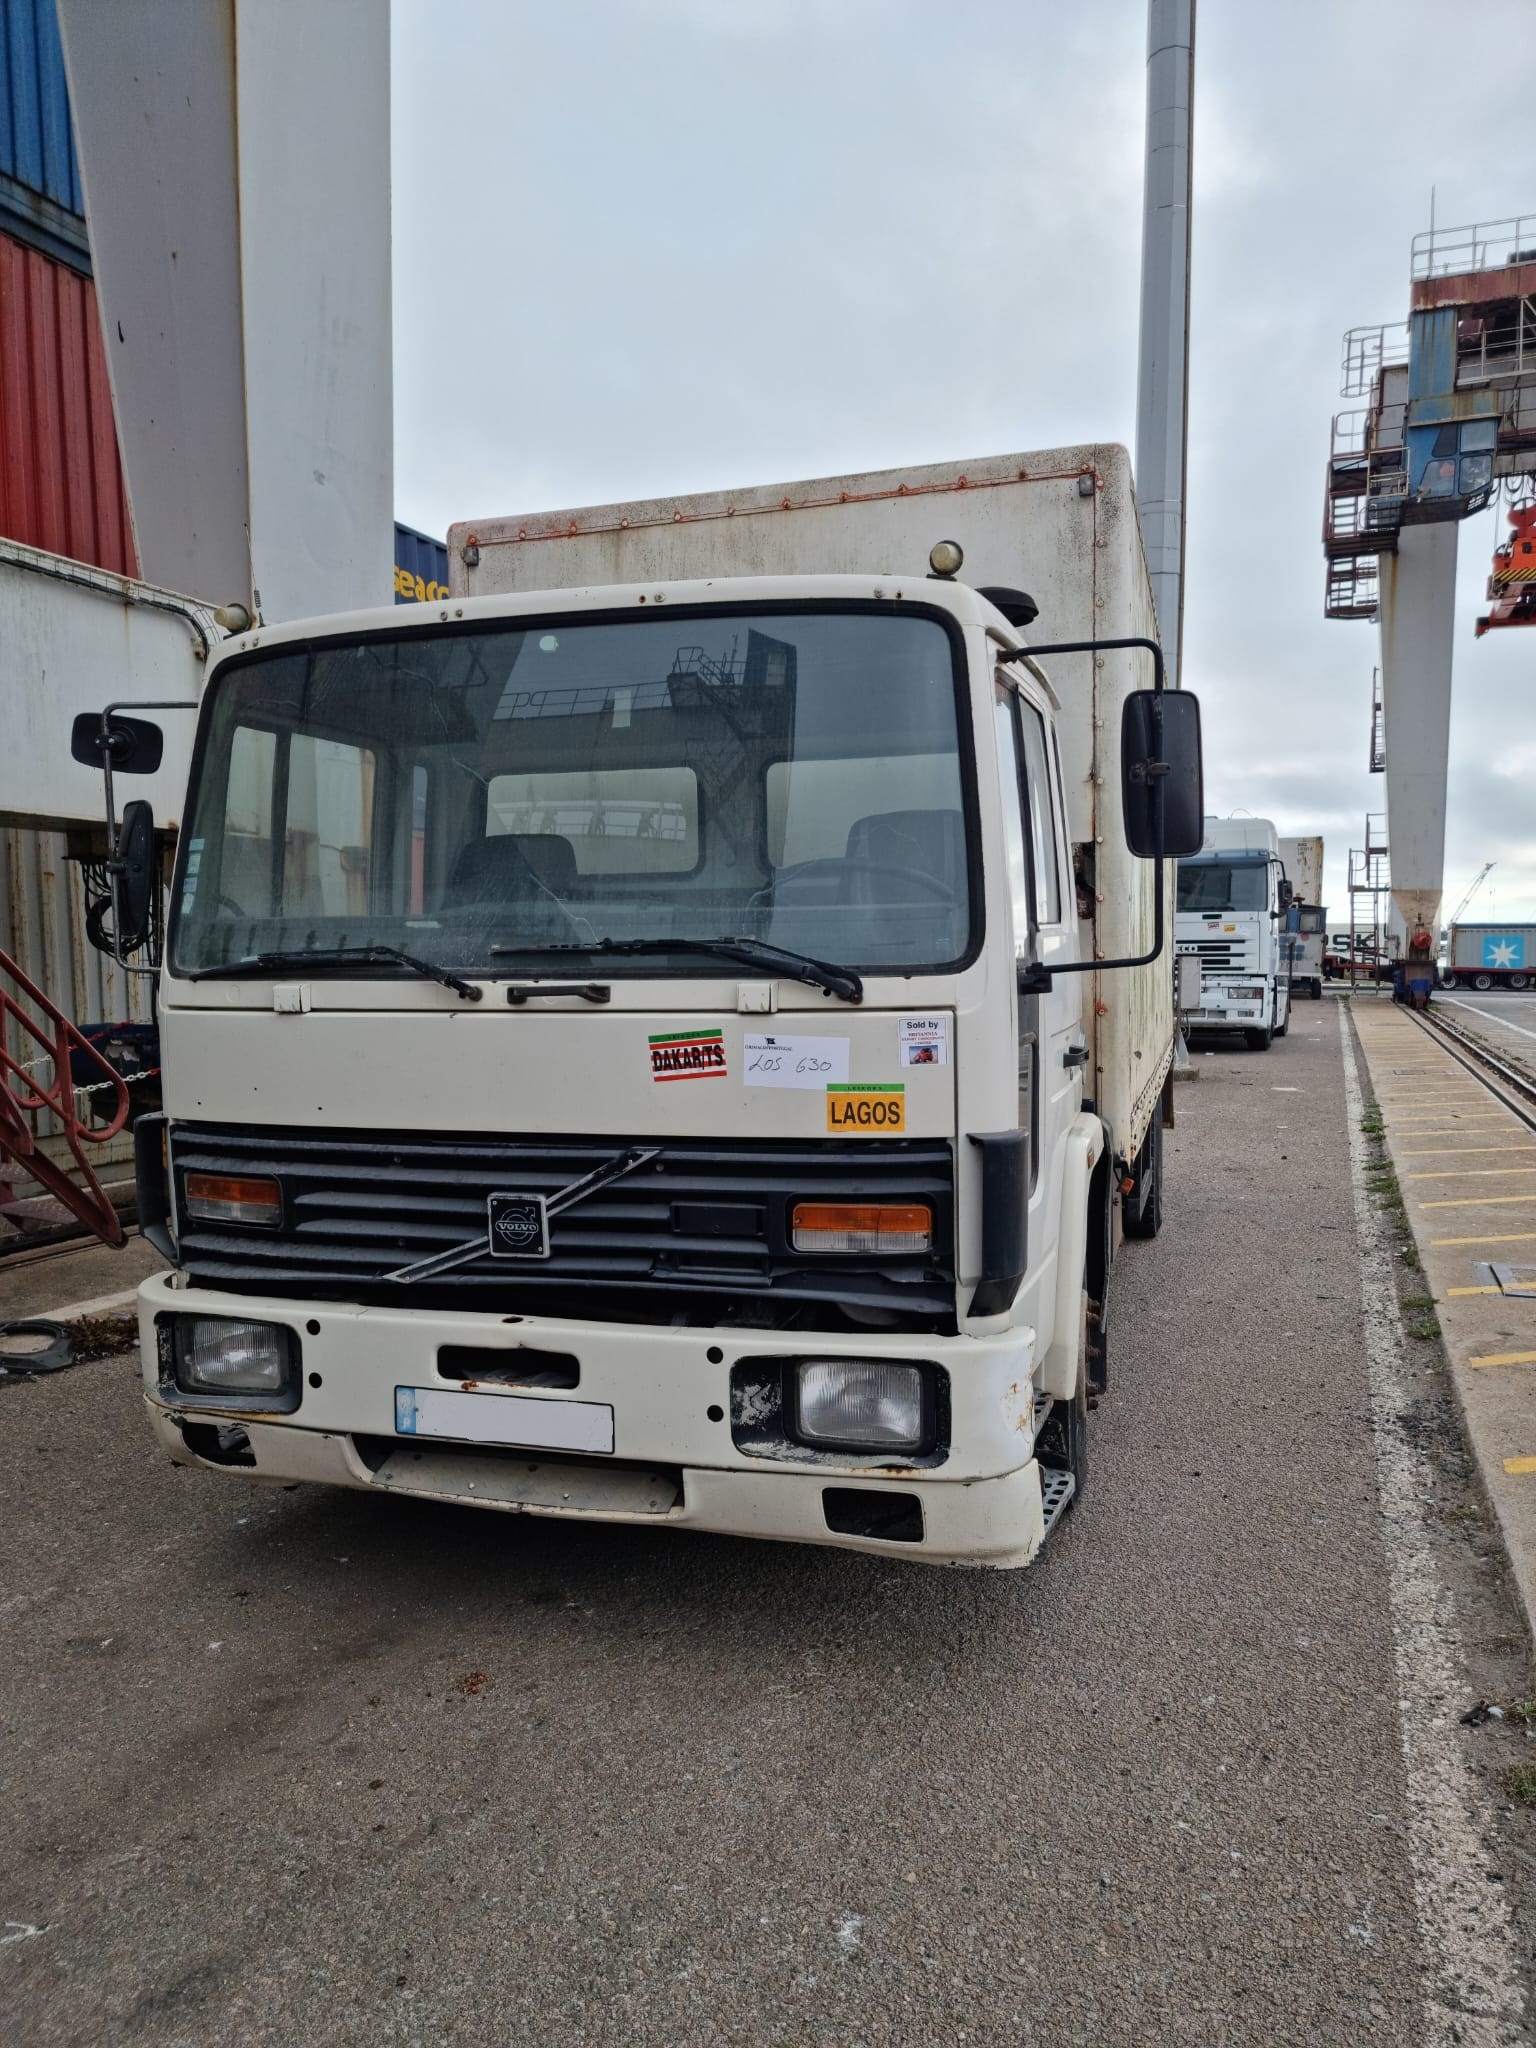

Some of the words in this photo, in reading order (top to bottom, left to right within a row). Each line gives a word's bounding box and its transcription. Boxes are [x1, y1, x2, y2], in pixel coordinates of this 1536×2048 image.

[906, 1021, 926, 1029] Sold
[928, 1020, 939, 1030] by
[795, 1057, 832, 1073] 630
[831, 1101, 900, 1125] LAGOS
[498, 1222, 537, 1231] VOLVO
